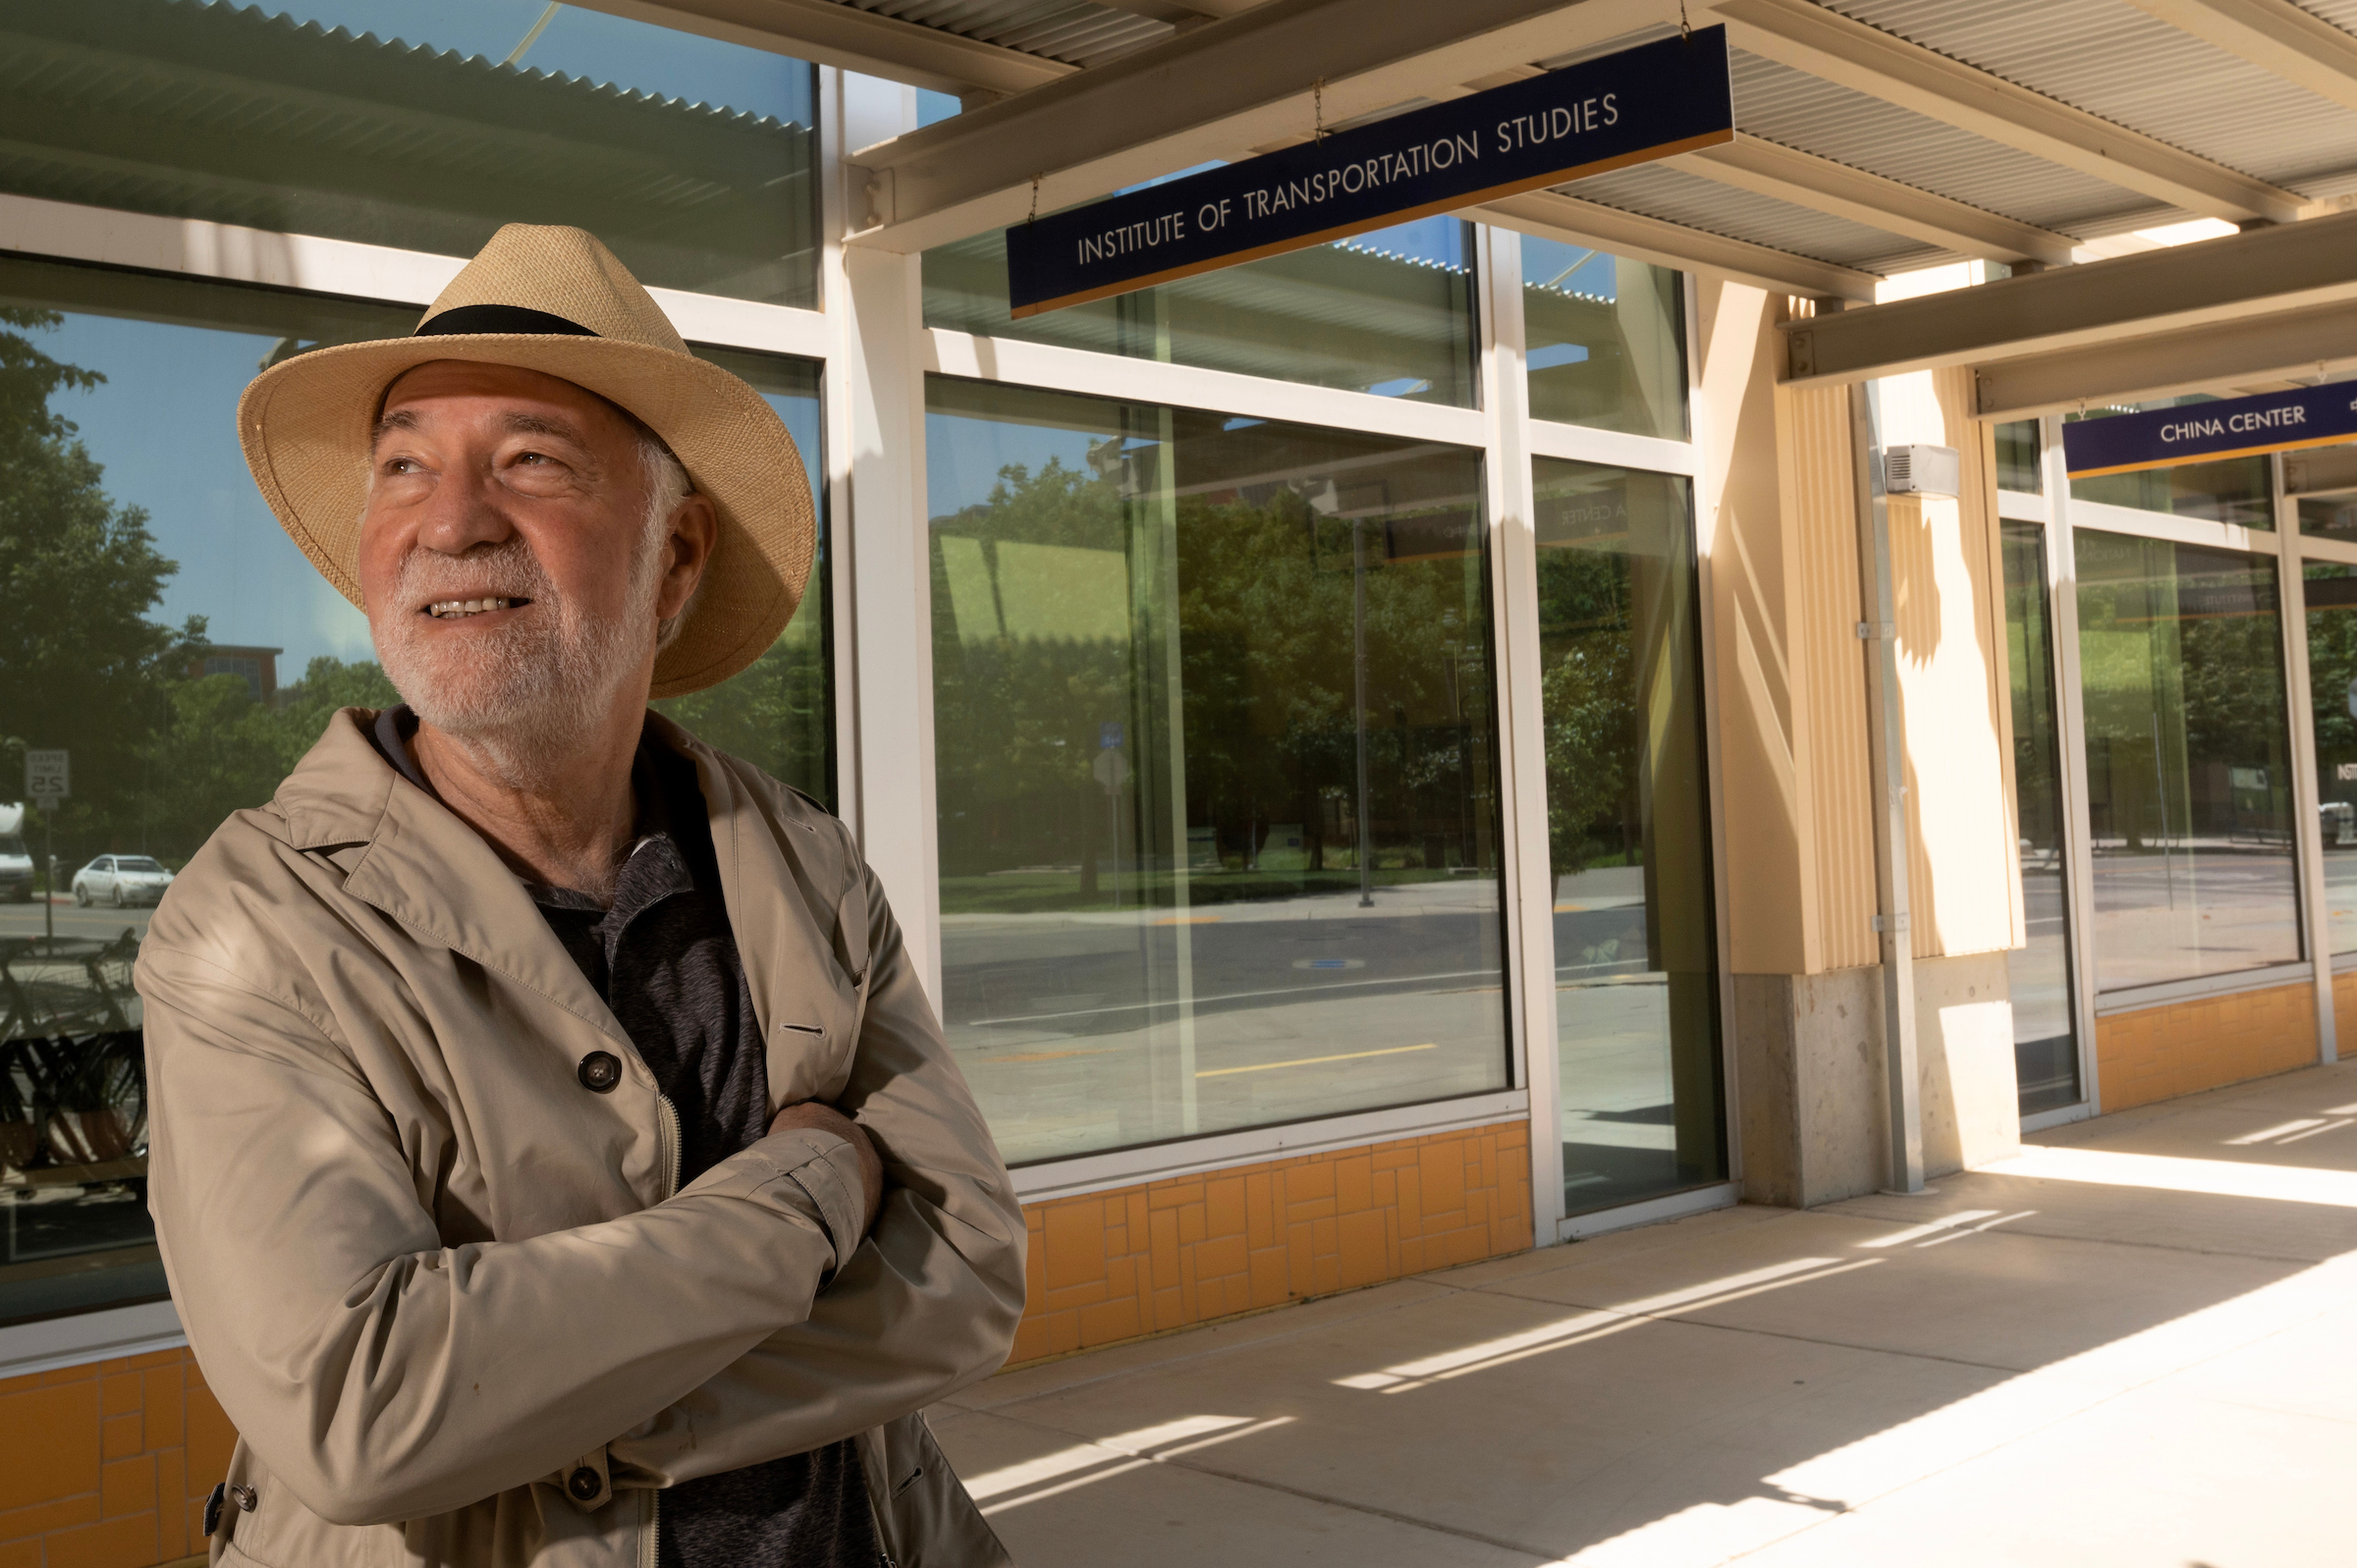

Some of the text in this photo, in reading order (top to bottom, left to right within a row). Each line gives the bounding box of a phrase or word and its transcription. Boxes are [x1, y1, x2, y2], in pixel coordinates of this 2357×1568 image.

[1077, 92, 1619, 265] INSTITUTE OF TRANSPORTATION STUDIES
[2160, 405, 2307, 443] CHINA CENTER
